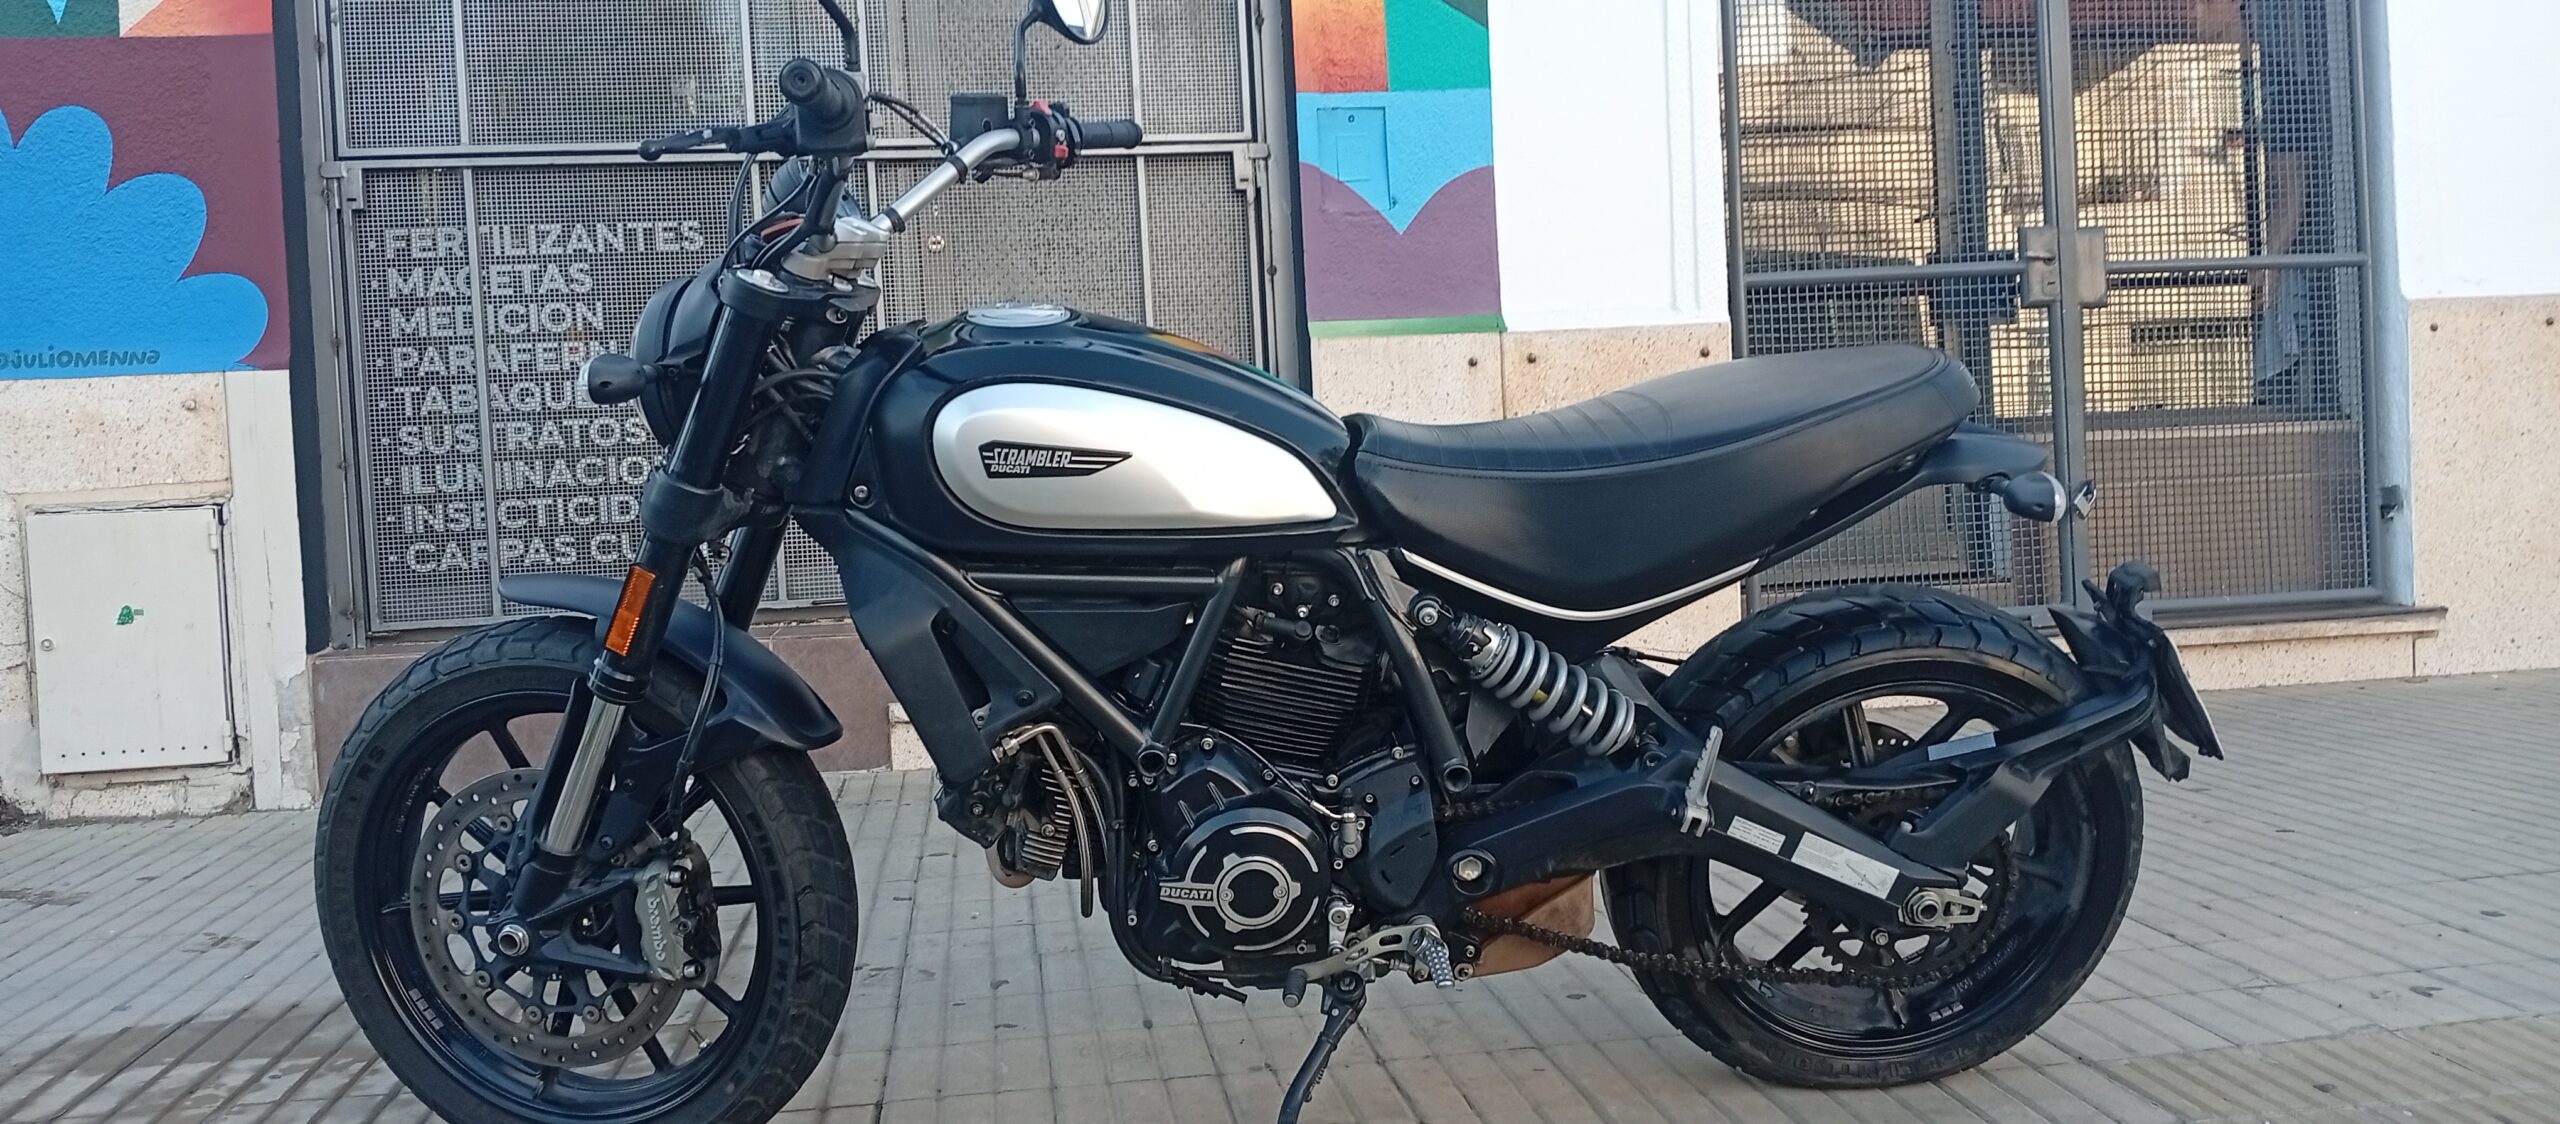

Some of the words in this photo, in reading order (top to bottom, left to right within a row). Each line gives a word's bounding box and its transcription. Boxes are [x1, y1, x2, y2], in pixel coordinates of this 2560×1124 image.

[391, 301, 604, 339] MEDICION
[990, 464, 1031, 474] DUCATI
[991, 448, 1073, 468] SCRAMBLER
[407, 534, 578, 573] CARPAS
[1160, 887, 1212, 900] DUCATI
[647, 898, 669, 962] brembo
